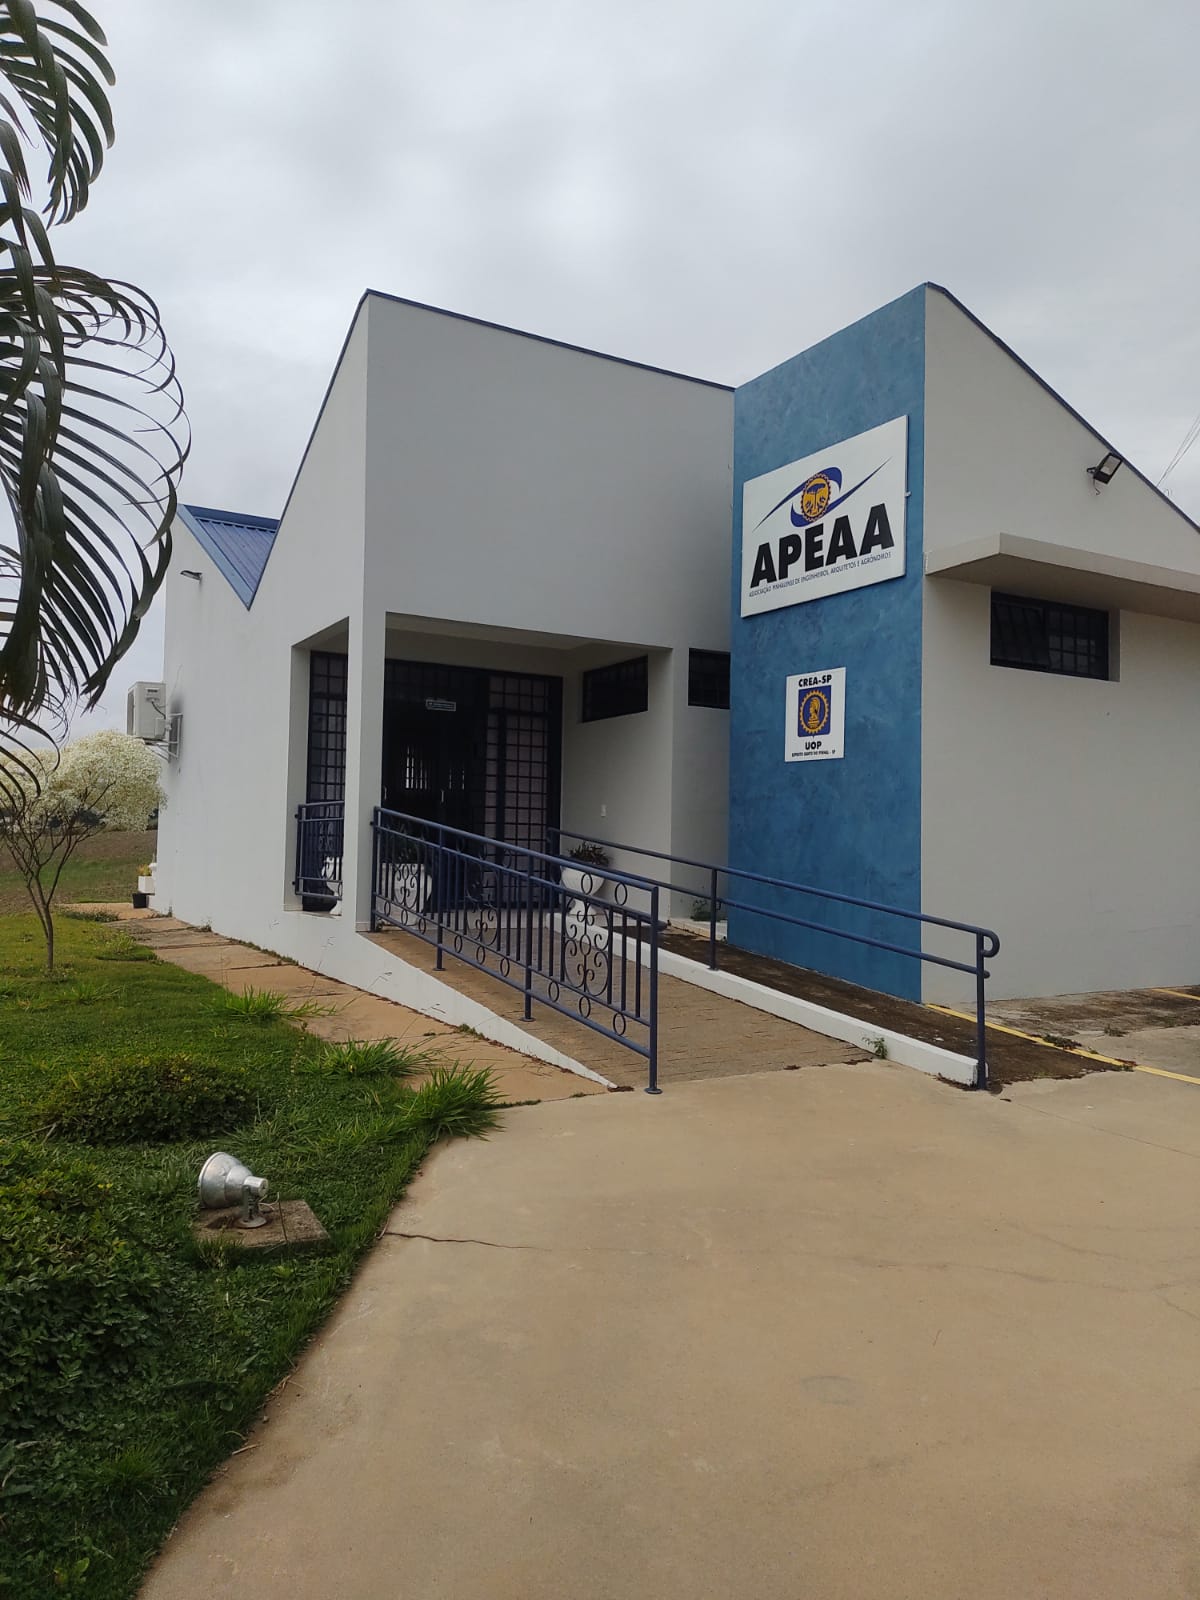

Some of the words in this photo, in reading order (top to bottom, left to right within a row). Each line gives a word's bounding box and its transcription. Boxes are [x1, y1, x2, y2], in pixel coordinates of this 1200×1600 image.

[750, 503, 894, 588] APEAA
[799, 675, 832, 687] CREA-SP
[805, 740, 822, 750] UOP
